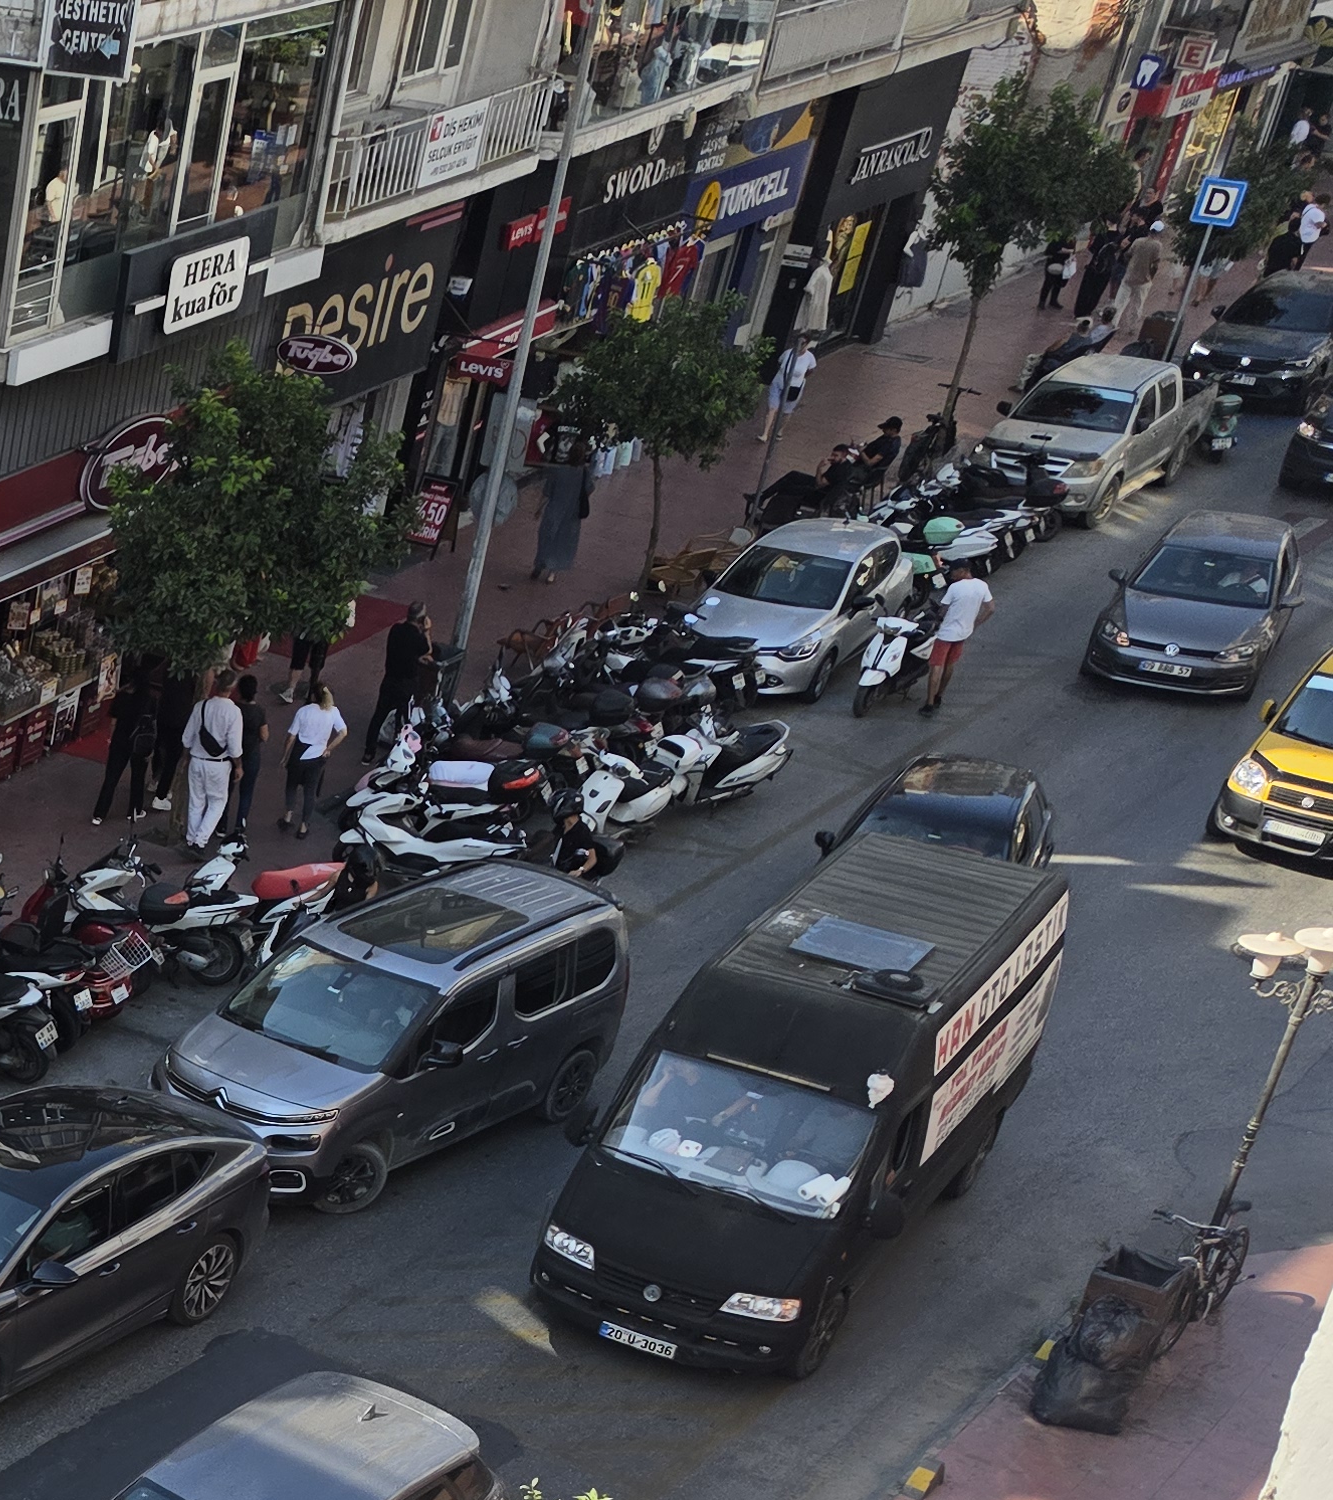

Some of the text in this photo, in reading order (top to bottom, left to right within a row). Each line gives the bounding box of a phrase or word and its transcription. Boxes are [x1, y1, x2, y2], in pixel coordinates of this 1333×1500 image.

[603, 158, 666, 203] SWORD
[720, 167, 790, 220] TURKCELL
[1204, 188, 1230, 215] D
[183, 249, 236, 288] HERA
[171, 281, 238, 324] kuaför
[937, 1002, 976, 1071] HAN
[978, 966, 1010, 1026] OTO
[608, 1327, 622, 1340] 20
[640, 1339, 673, 1356] 3036
